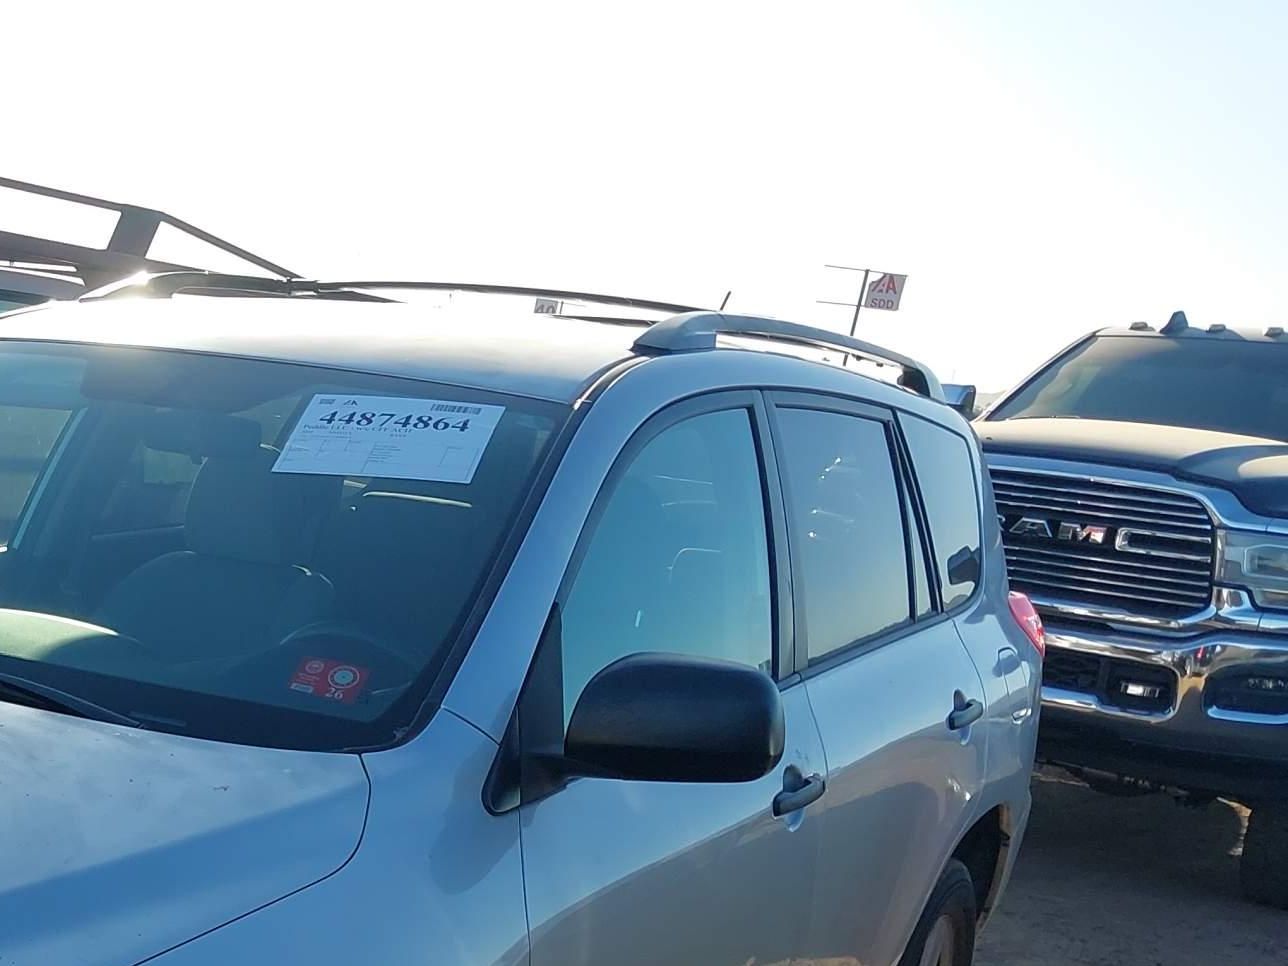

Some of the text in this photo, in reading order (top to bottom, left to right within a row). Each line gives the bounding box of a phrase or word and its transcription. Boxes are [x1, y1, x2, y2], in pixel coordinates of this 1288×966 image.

[319, 410, 470, 432] 44874864
[998, 514, 1108, 544] AM
[325, 687, 343, 699] 26
